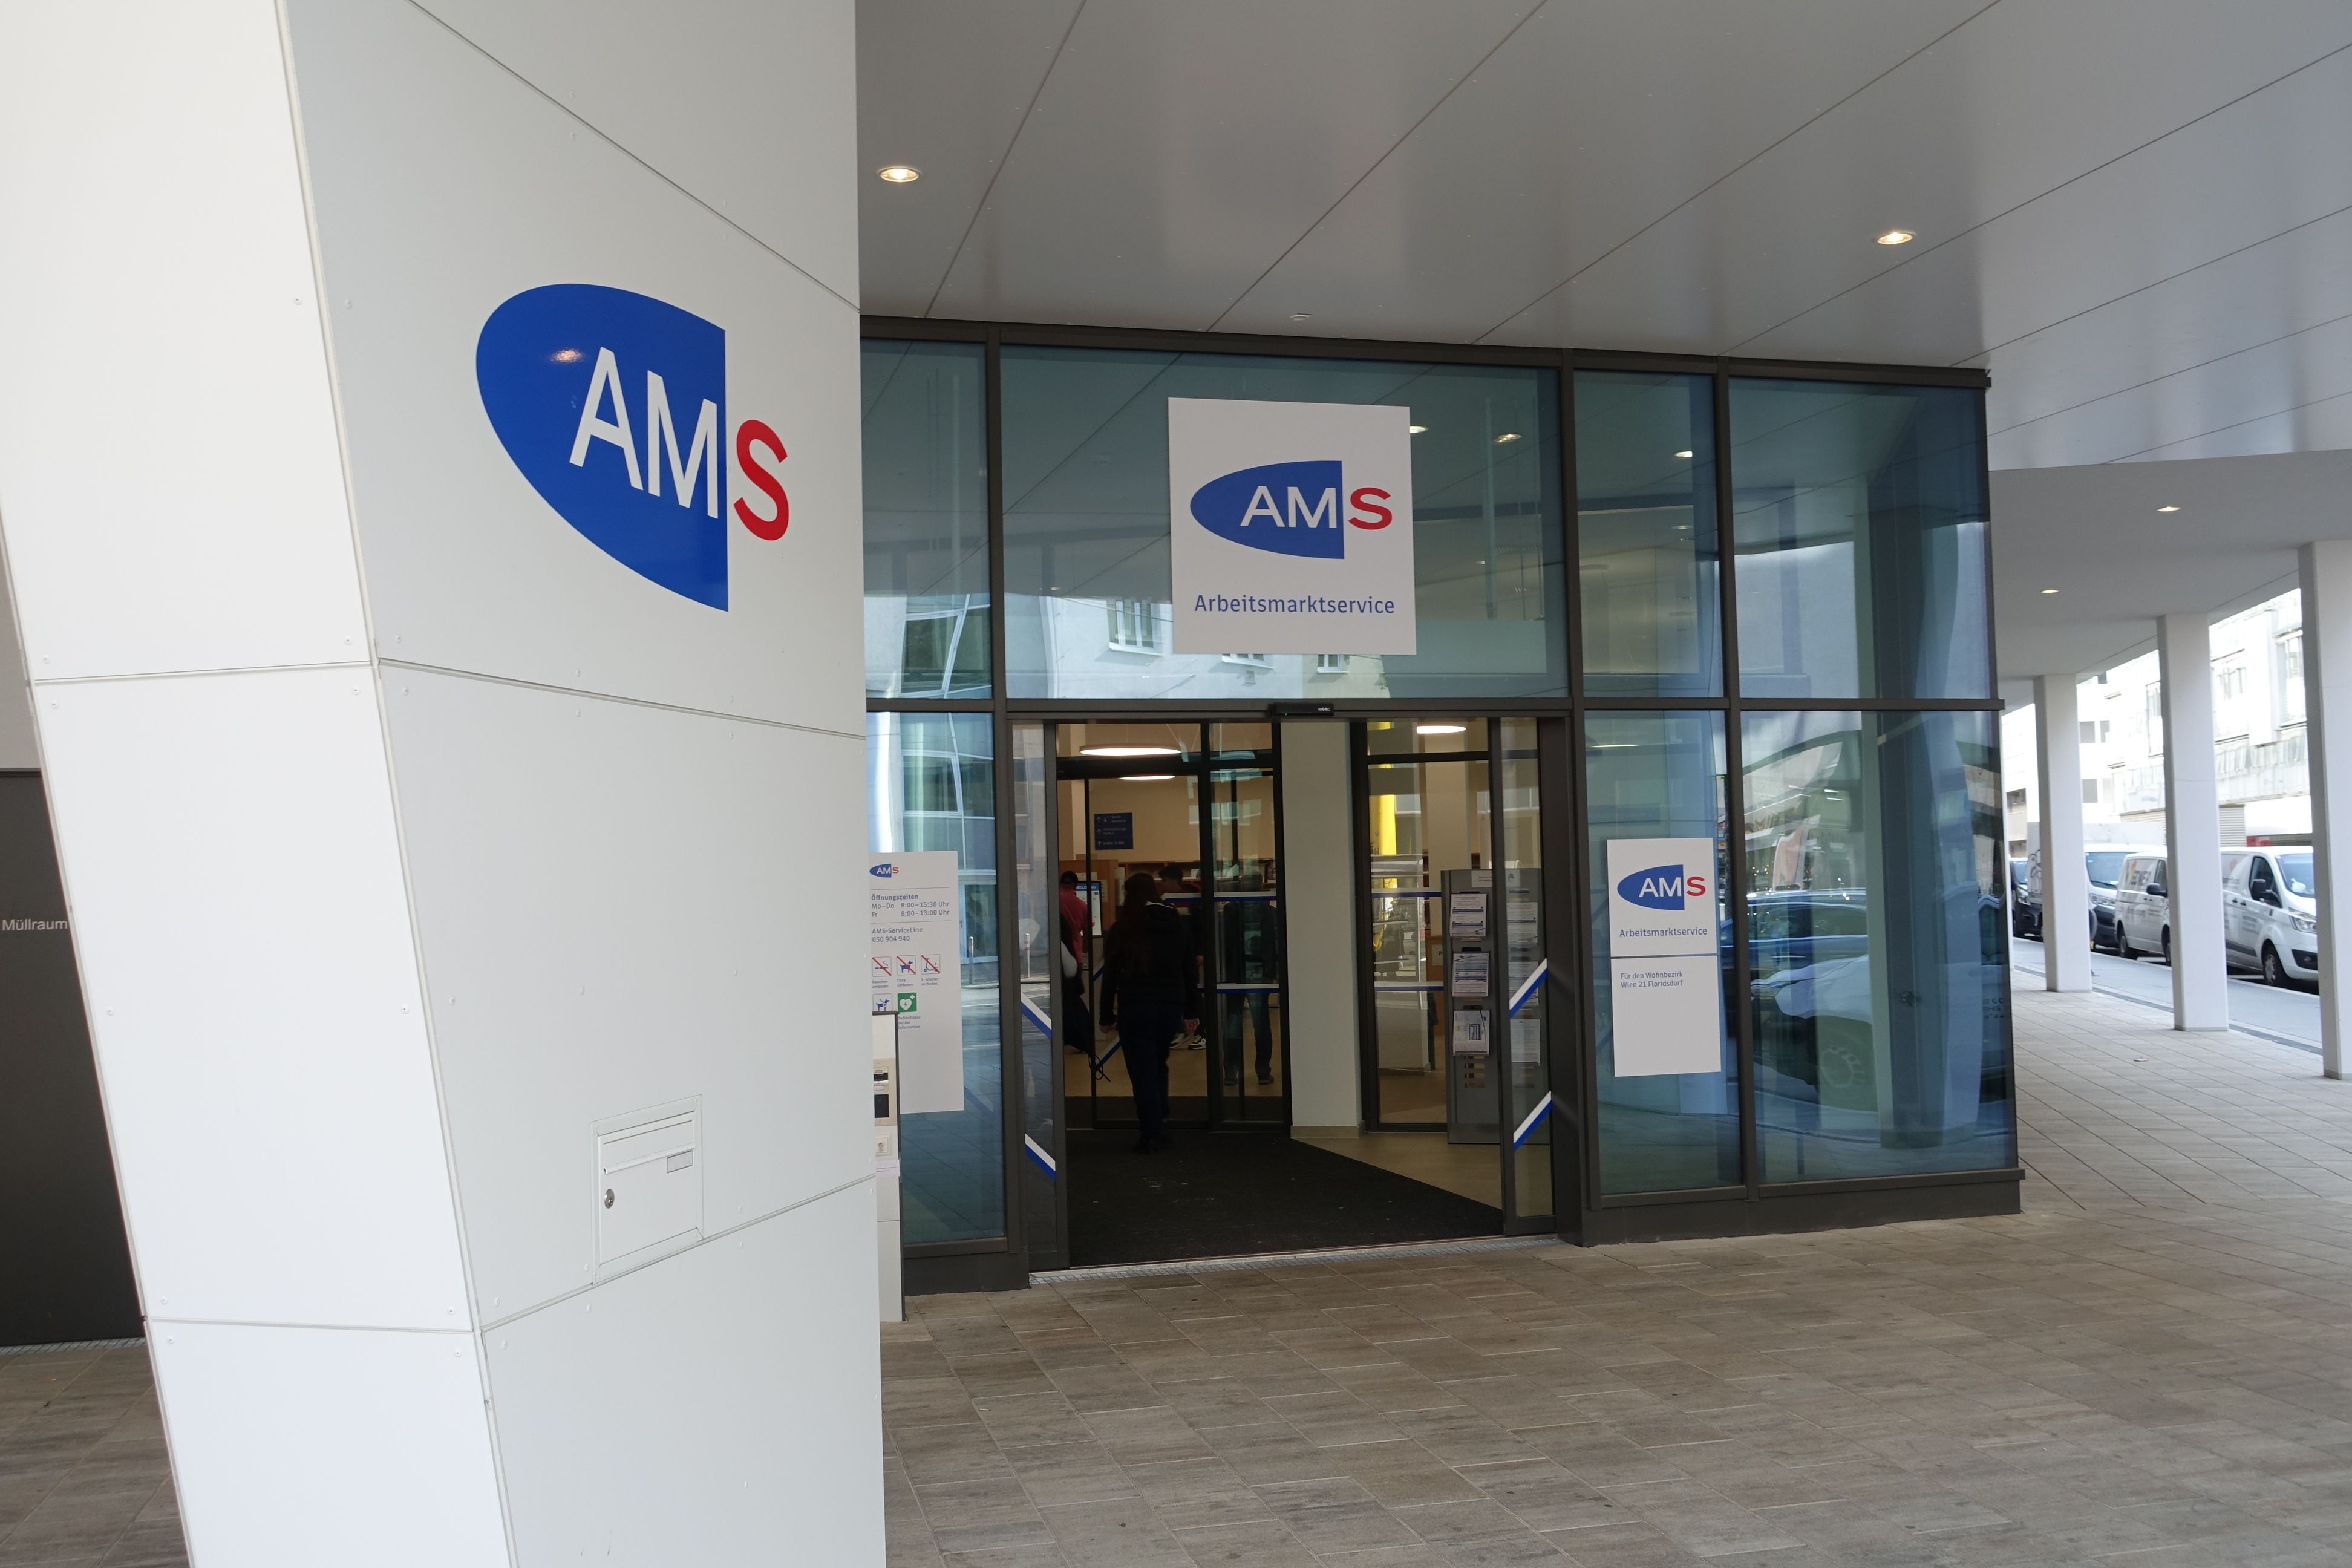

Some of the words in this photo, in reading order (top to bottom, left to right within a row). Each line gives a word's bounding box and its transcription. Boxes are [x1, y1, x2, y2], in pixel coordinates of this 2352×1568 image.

[569, 346, 789, 541] AMS
[1240, 485, 1393, 530] AMS
[1194, 594, 1395, 613] Arbeitsmarktservice
[1638, 876, 1706, 898] AMS
[2, 918, 68, 931] Müllraum
[1619, 926, 1708, 938] Arbeitsmarktservice
